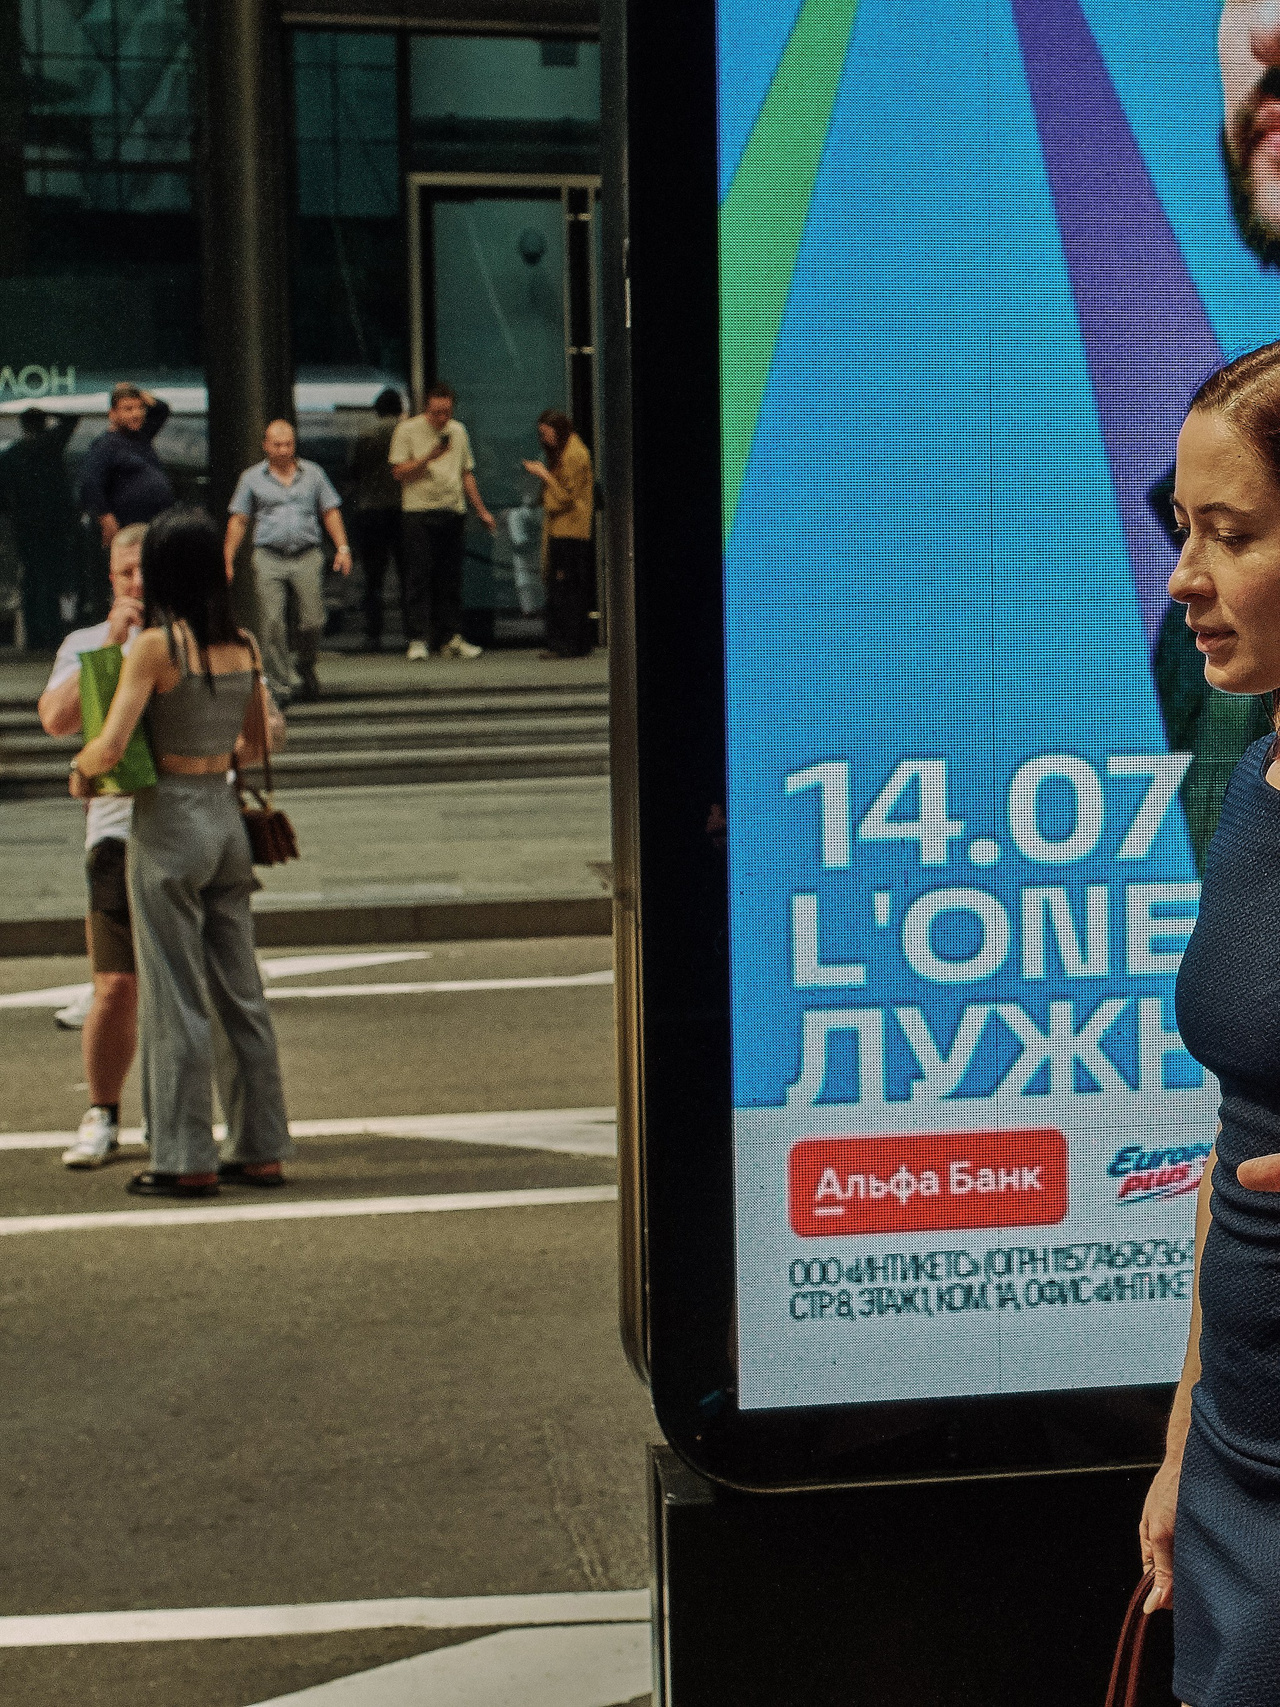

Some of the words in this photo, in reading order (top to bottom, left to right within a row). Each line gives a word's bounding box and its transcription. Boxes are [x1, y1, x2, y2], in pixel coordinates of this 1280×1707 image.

[784, 753, 1195, 869] 14.07
[792, 881, 1202, 989] L'ONE
[814, 1164, 941, 1206] Альфа
[949, 1160, 1045, 1195] Банк
[788, 1257, 843, 1287] ООО
